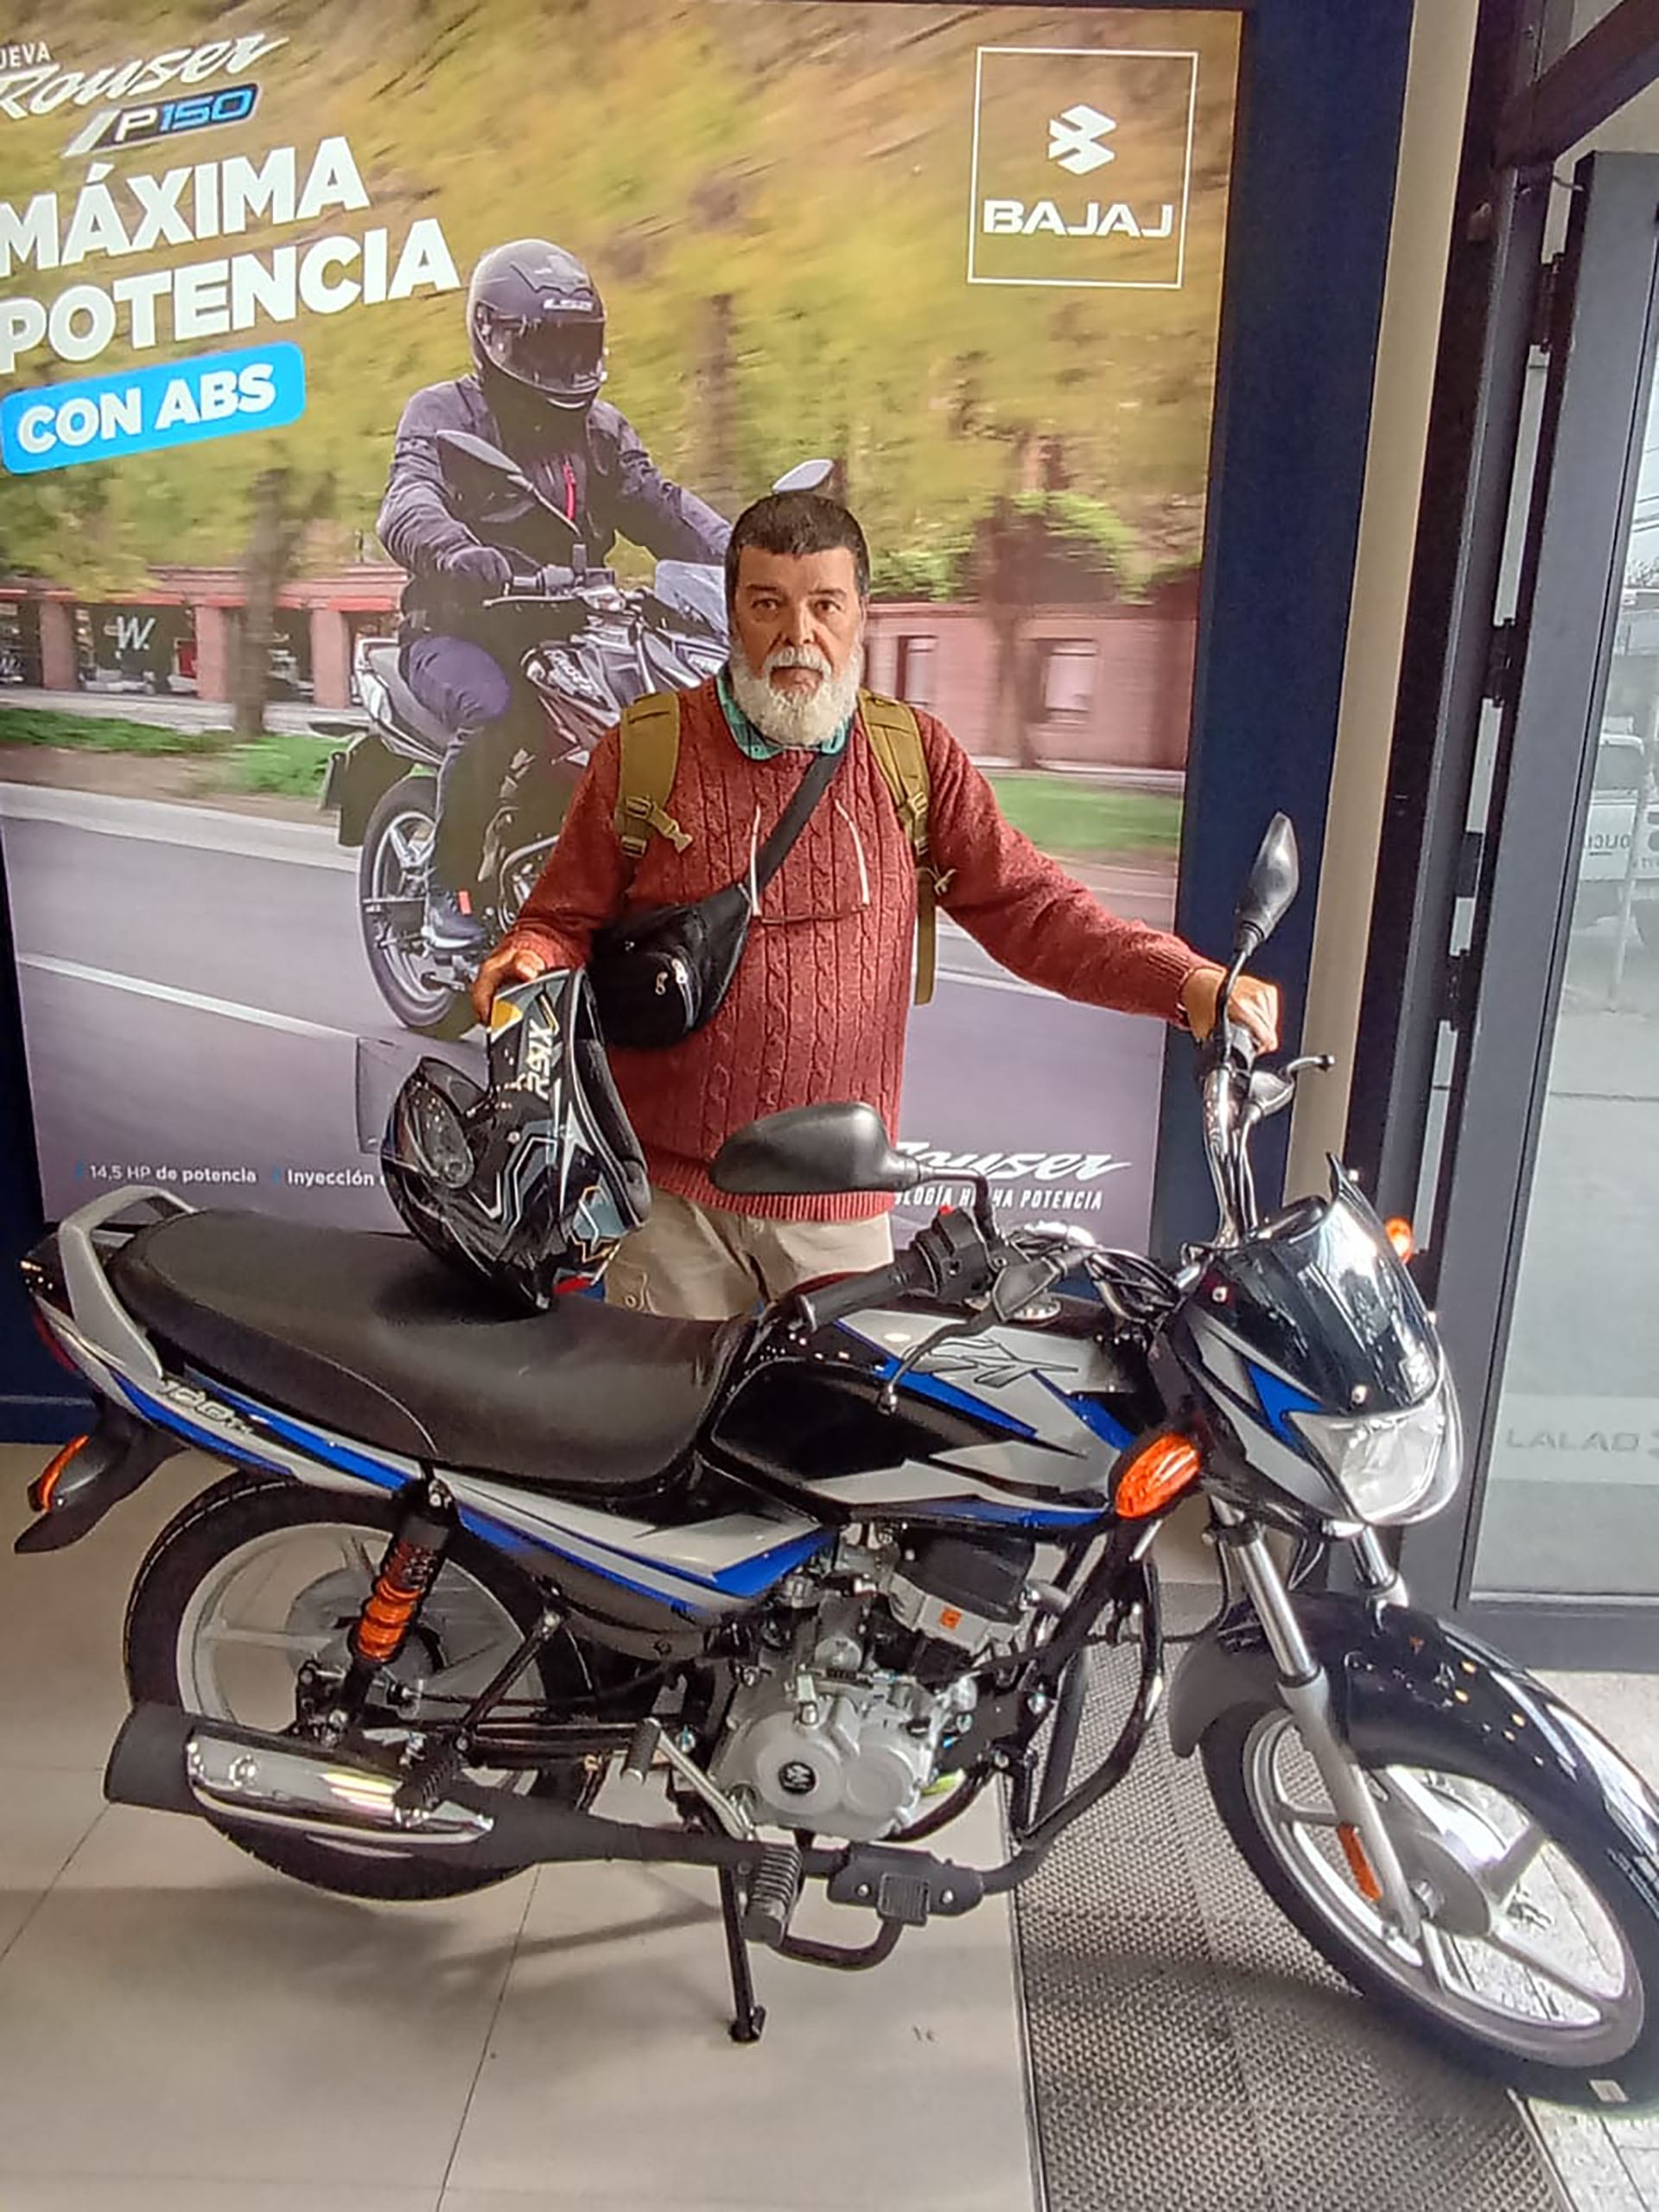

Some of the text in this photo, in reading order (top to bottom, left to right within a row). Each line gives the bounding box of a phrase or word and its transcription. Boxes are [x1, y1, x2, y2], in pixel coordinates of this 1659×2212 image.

[0, 33, 289, 119] Rouser
[0, 136, 371, 277] MÁXIMA
[982, 199, 1173, 238] BAJAJ
[0, 218, 461, 375] POTENCIA
[17, 363, 276, 454] CON ABS
[90, 1165, 257, 1185] 14,5 HP de potencia
[288, 1168, 375, 1186] Inyección
[1020, 1189, 1103, 1210] POTENCIA
